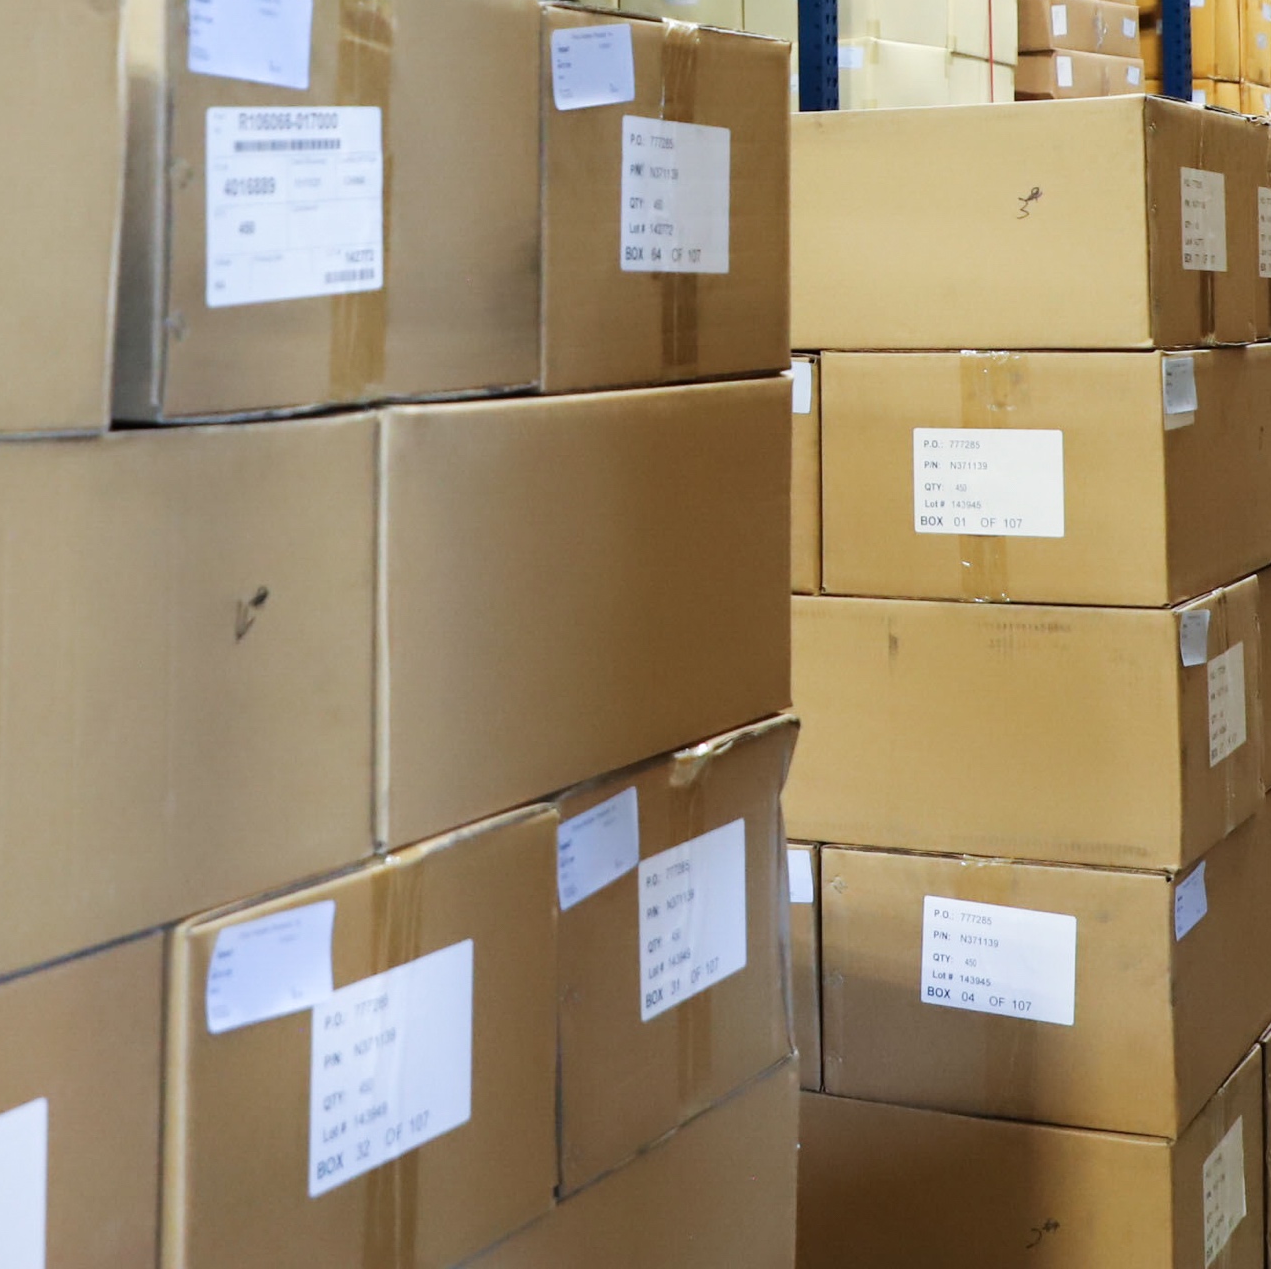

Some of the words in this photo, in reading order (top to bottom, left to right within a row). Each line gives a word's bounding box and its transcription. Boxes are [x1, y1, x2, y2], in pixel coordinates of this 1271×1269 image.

[625, 247, 644, 261] BOX
[671, 248, 682, 262] OF
[923, 440, 944, 449] P.O.:
[949, 440, 981, 449] 777285
[924, 461, 941, 469] P/N:
[950, 461, 988, 470] N371139
[924, 483, 944, 491] QTY:
[955, 484, 967, 492] 450
[924, 500, 938, 508] Lot
[939, 500, 946, 508] #
[920, 516, 944, 527] BOX
[953, 516, 966, 527] 01
[980, 517, 997, 528] OF
[1004, 518, 1023, 529] 107
[934, 909, 954, 920] P.O.:
[960, 913, 992, 925] 777285
[933, 930, 951, 941] P/N:
[960, 934, 999, 948] N371139
[932, 953, 953, 963] QTY:
[965, 958, 977, 968] 450
[932, 970, 946, 980] Lot
[947, 973, 954, 981] #
[645, 988, 664, 1009] BOX
[691, 966, 701, 984] OF
[927, 986, 951, 1000] BOX
[961, 991, 975, 1003] 04
[989, 996, 1006, 1007] OF
[1012, 999, 1032, 1012] 107
[316, 1152, 345, 1181] BOX
[385, 1123, 403, 1146] OF
[409, 1109, 429, 1135] 107
